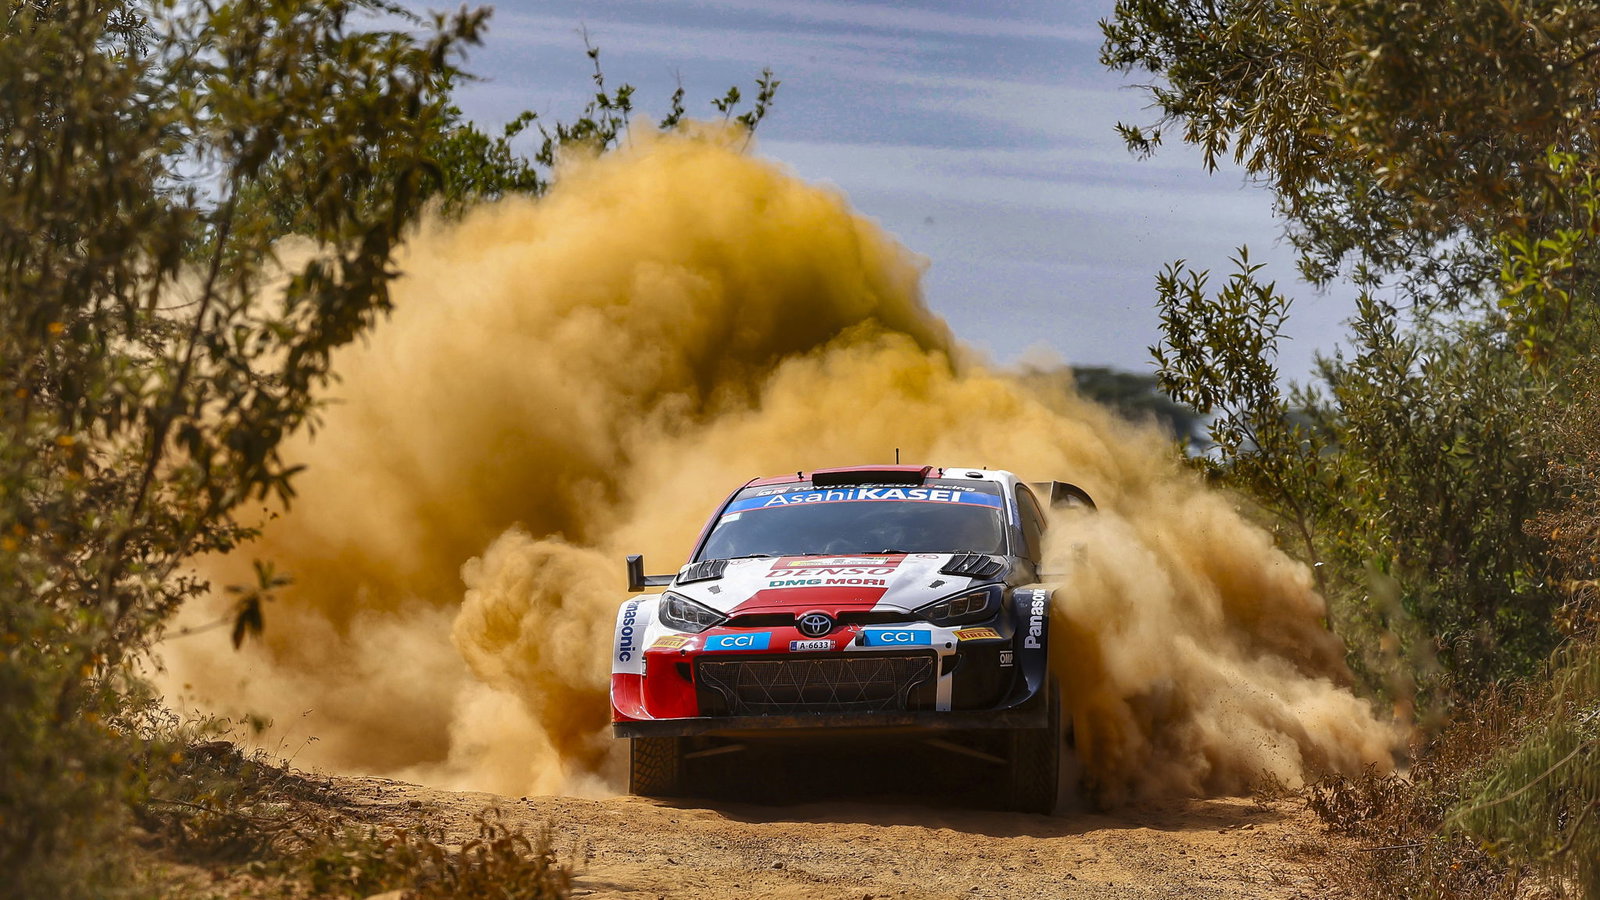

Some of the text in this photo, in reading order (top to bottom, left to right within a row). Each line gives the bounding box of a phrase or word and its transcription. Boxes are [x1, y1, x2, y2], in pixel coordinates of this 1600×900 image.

[765, 567, 896, 578] DENSO
[769, 579, 822, 587] DMG
[619, 600, 640, 662] anasonic
[1025, 588, 1046, 649] Panason
